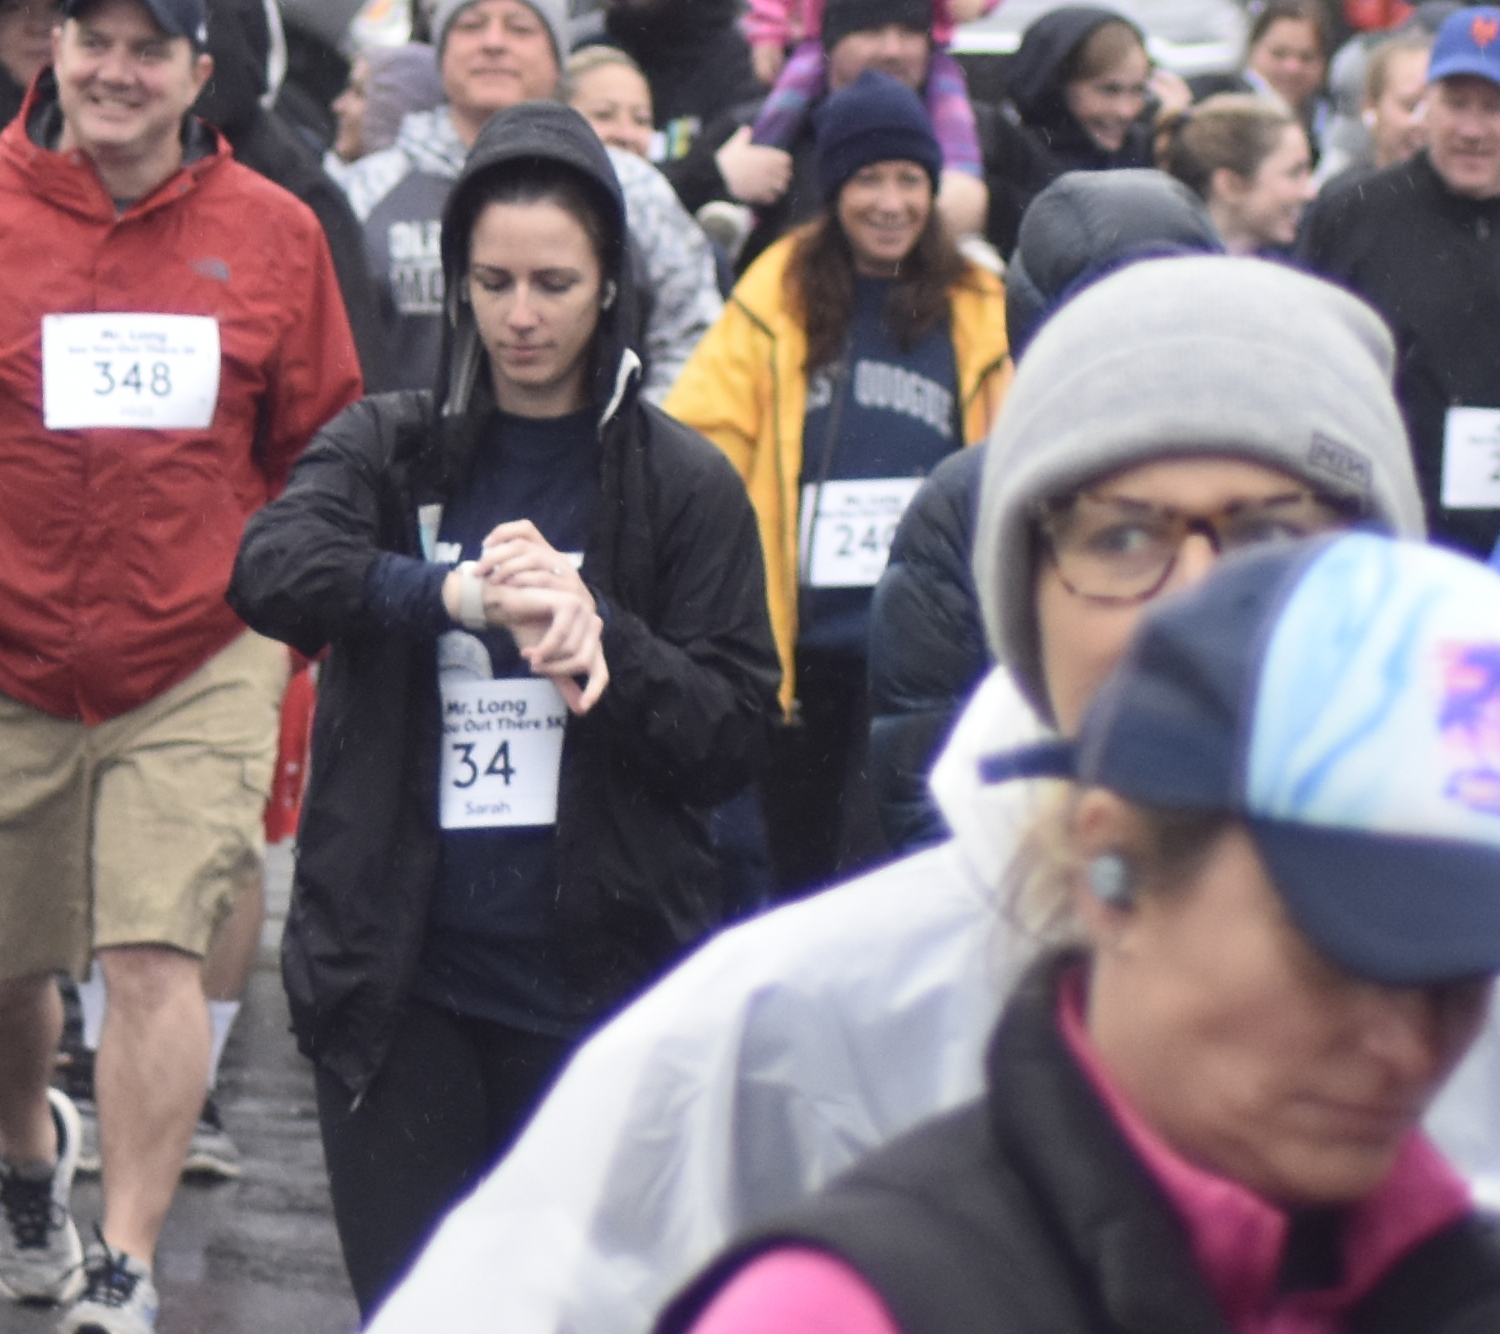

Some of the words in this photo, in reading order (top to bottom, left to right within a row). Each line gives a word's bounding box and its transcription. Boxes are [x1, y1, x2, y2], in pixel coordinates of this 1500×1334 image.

[93, 361, 173, 398] 348
[446, 699, 473, 716] Mr.
[477, 699, 527, 716] Long
[443, 721, 461, 734] ou
[467, 719, 495, 733] Out
[498, 717, 542, 732] There
[452, 739, 516, 789] 34
[464, 801, 512, 816] Sarah
